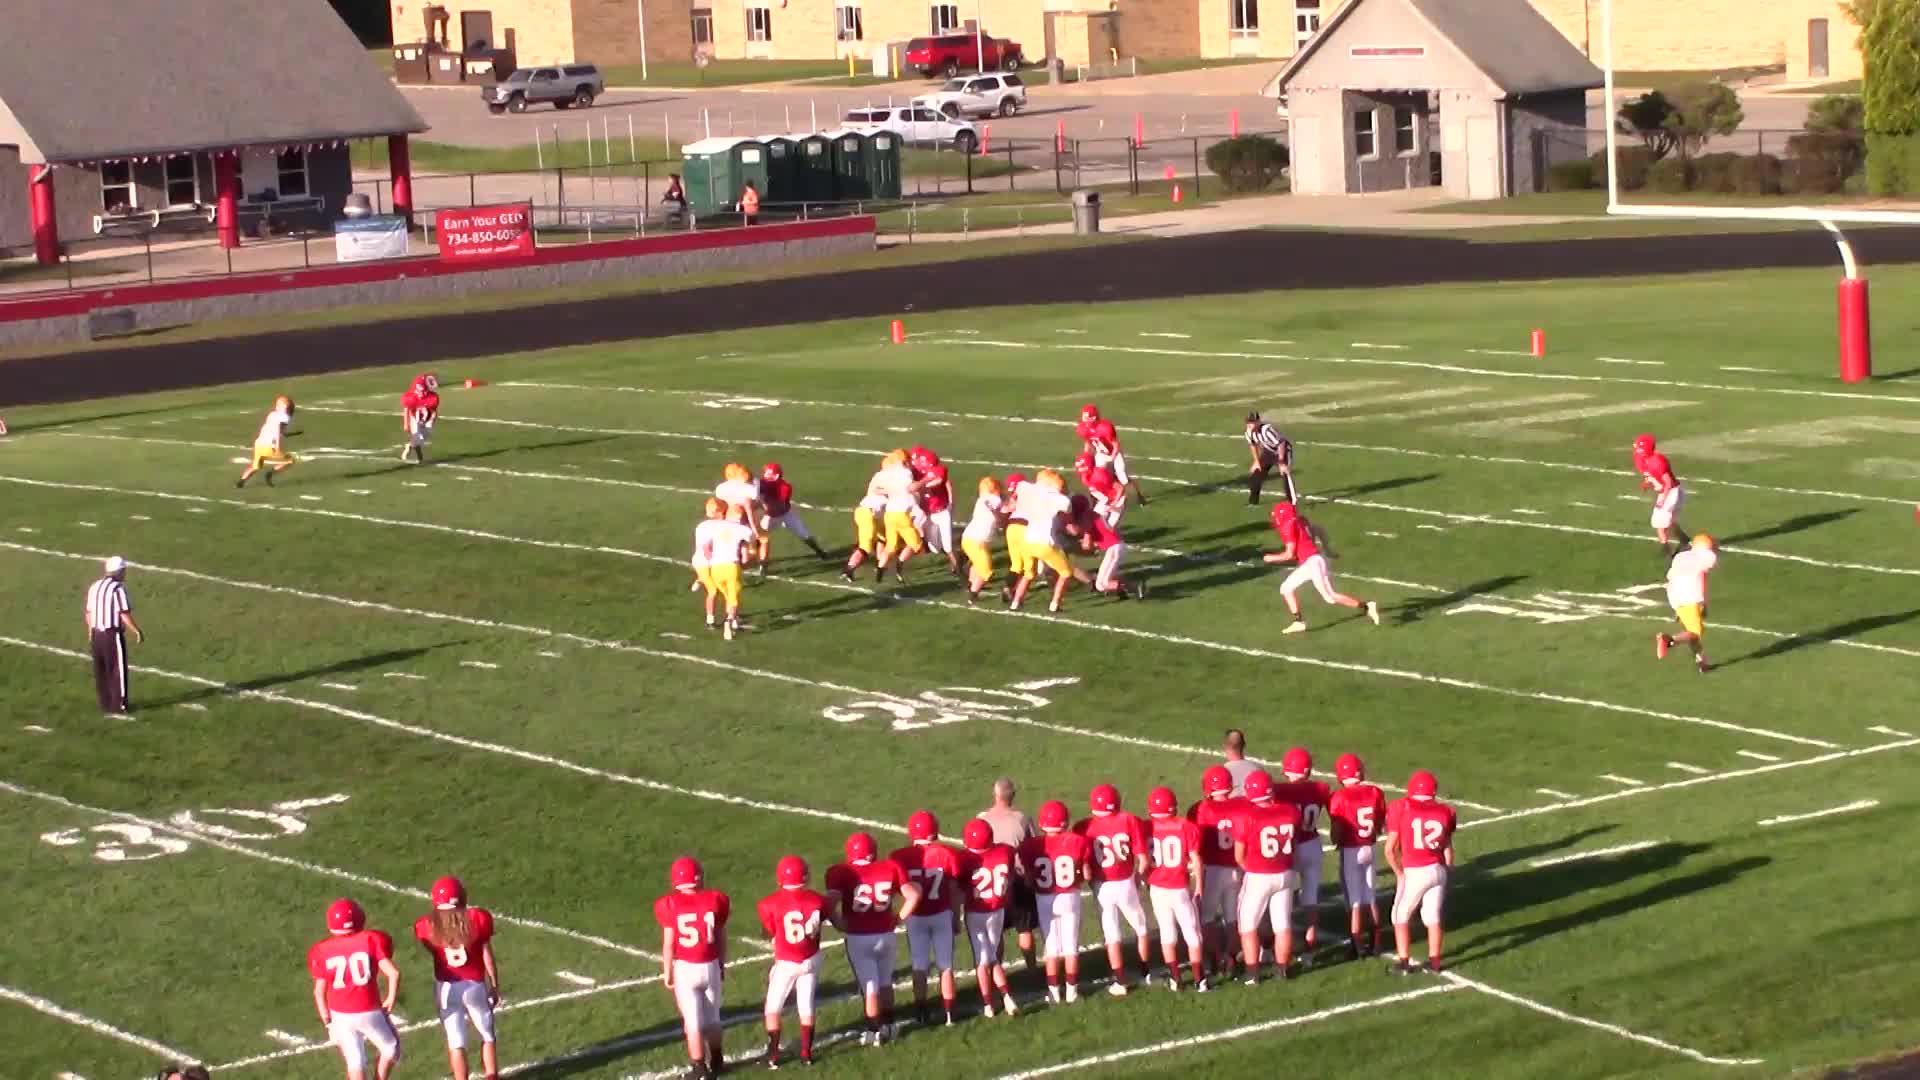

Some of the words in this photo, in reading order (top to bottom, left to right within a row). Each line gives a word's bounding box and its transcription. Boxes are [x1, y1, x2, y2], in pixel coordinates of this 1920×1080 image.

[444, 218, 470, 231] Earn
[471, 215, 497, 228] Your
[1357, 807, 1374, 838] 5
[1411, 817, 1443, 850] 12
[1260, 823, 1294, 859] 67
[971, 864, 1009, 899] 26
[1033, 855, 1075, 888] 38
[852, 881, 892, 912] 65
[677, 911, 715, 948] 51
[783, 910, 821, 944] 64
[325, 951, 371, 989] 70
